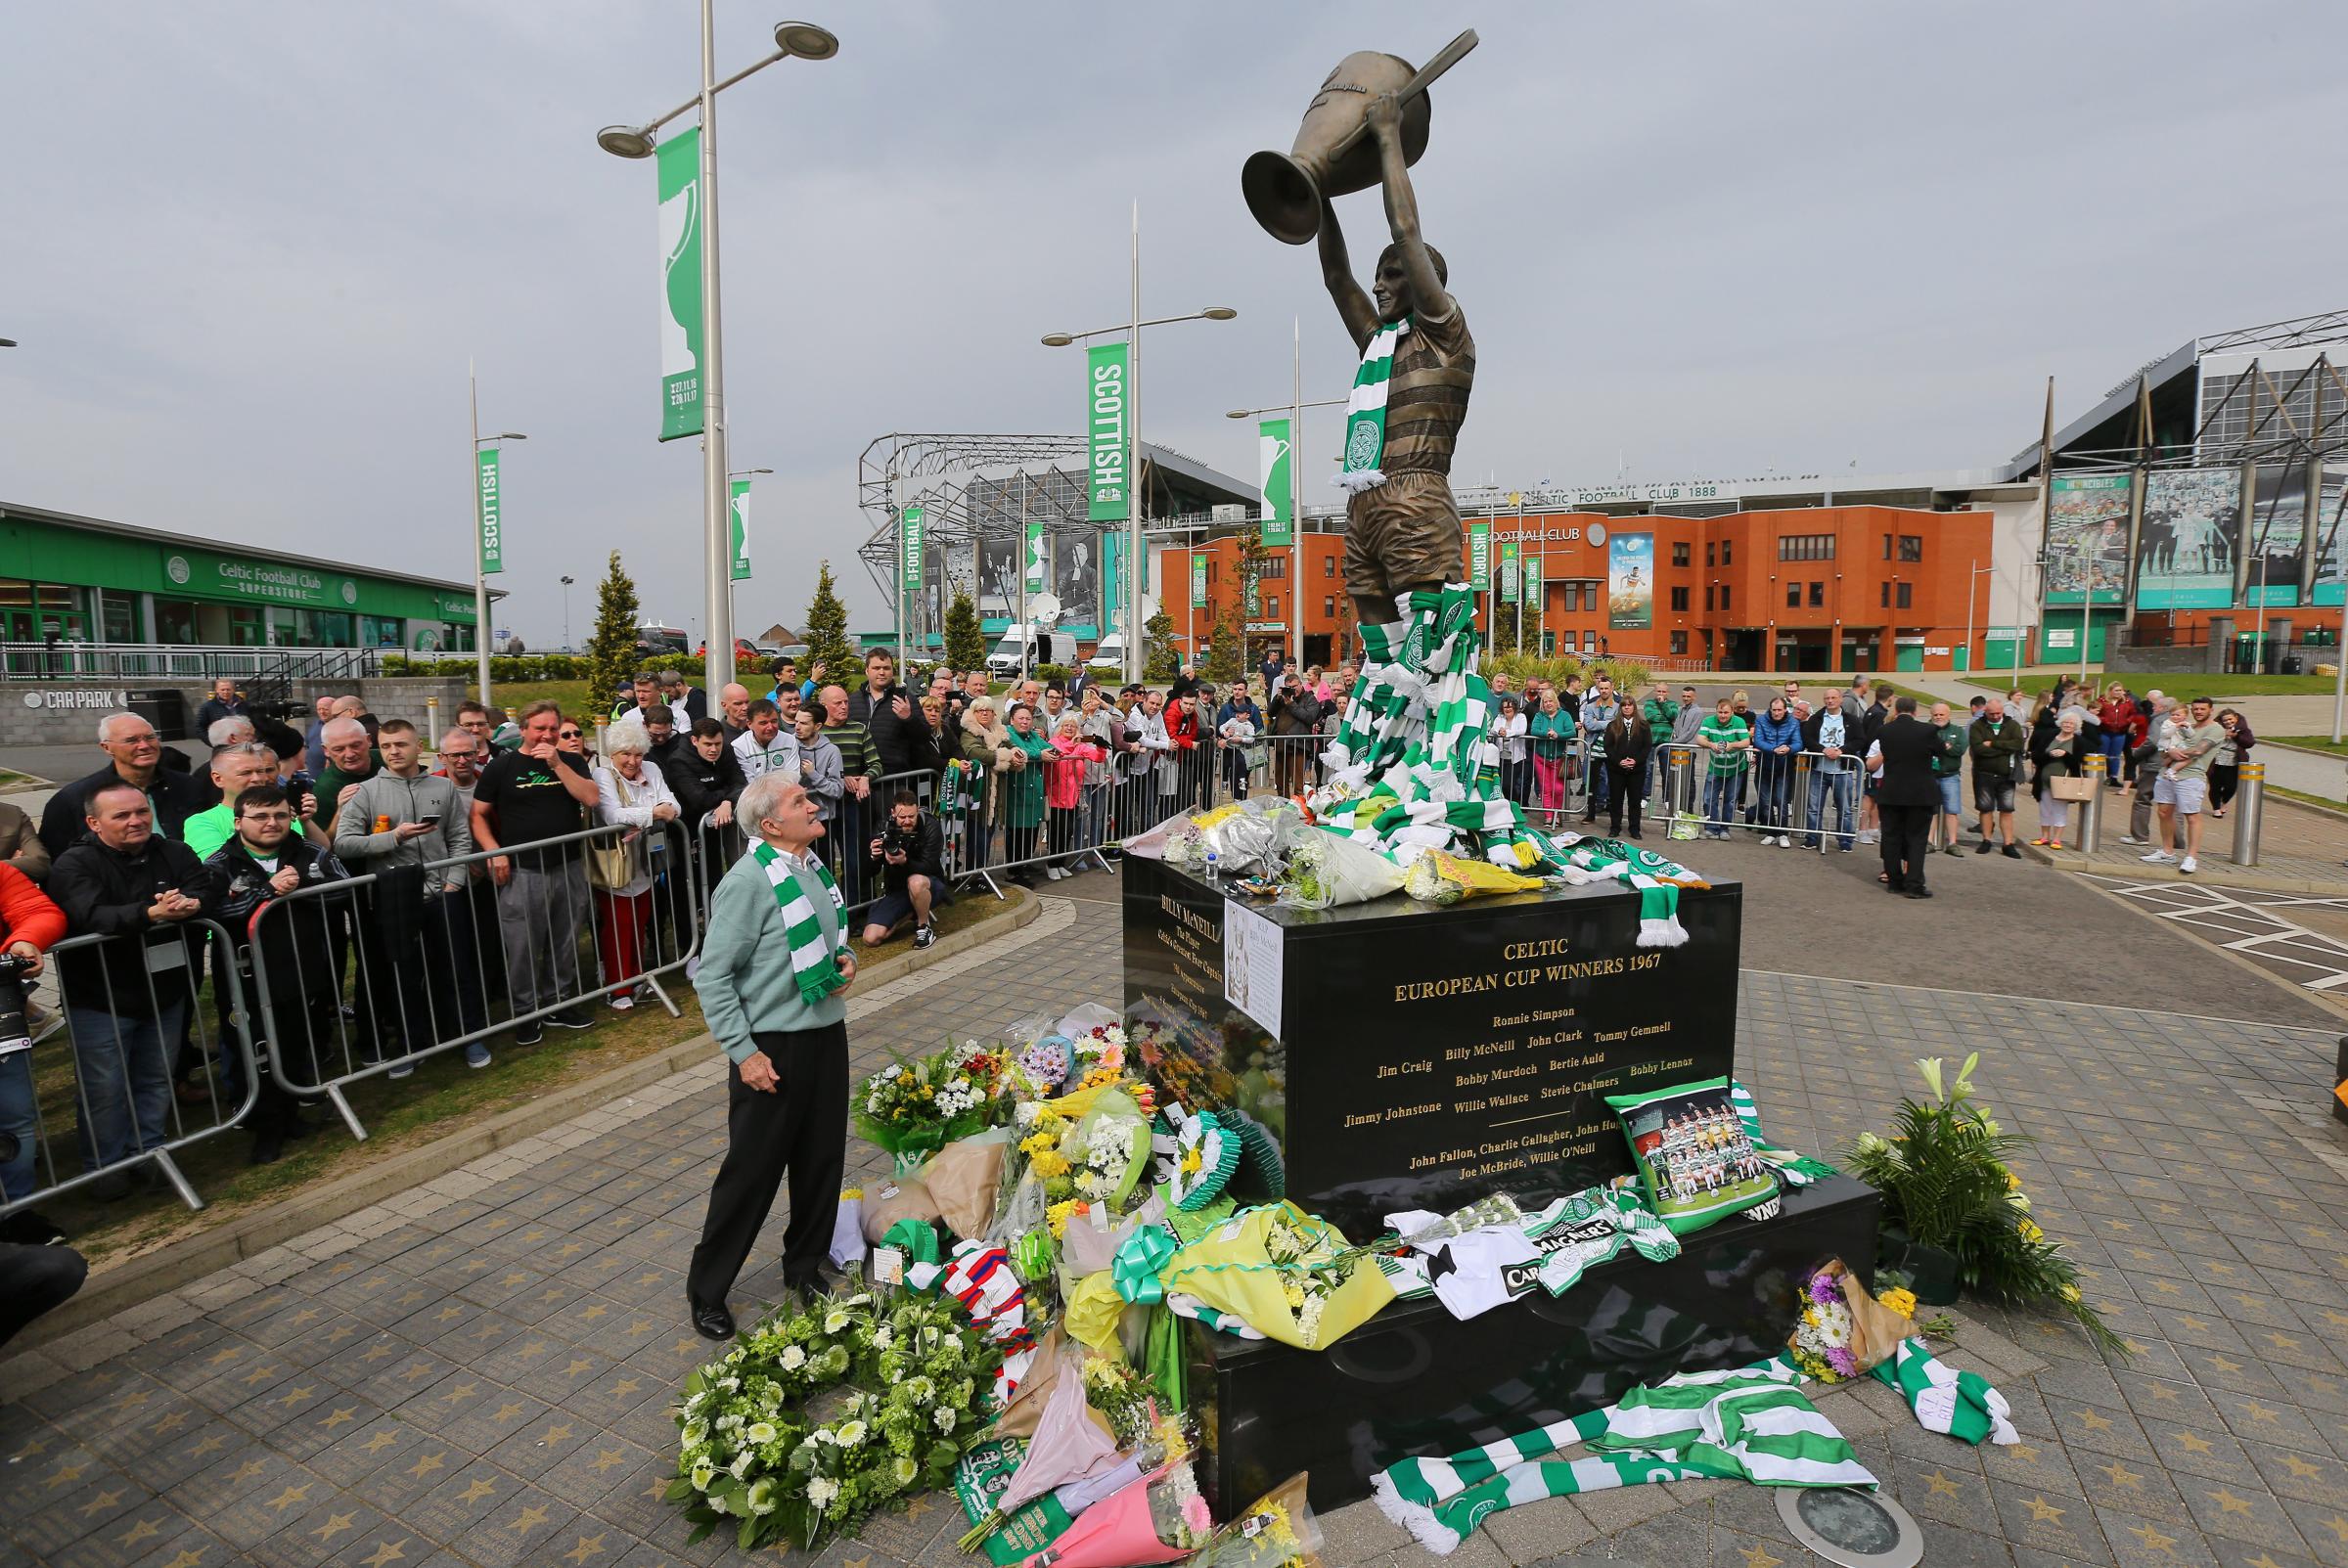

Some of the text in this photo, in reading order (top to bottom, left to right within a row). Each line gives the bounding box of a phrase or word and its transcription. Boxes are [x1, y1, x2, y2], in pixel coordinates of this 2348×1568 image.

[1094, 364, 1122, 485] SCOTTISH
[482, 464, 499, 548] SCOTTISH
[1648, 488, 1680, 500] CLUB
[1689, 486, 1717, 498] 1888
[907, 515, 921, 575] FOOTBALL
[1548, 527, 1581, 541] CLUB
[1472, 533, 1487, 577] HISTORY
[218, 561, 322, 590] Celtic Football Club
[238, 581, 308, 601] SUPERSTORE
[1528, 561, 1538, 600] SINCE 1888
[46, 691, 114, 709] CAR PARK
[946, 782, 955, 811] ELTIC
[1160, 894, 1219, 943] BILLY McNEILL
[1176, 925, 1200, 951] The Player
[1504, 938, 1569, 961] CELTIC
[1192, 952, 1202, 969] Ever
[1202, 961, 1223, 984] Captain
[1394, 952, 1662, 1003] EUROPEAN CUP WINNERS 1967
[1493, 1007, 1575, 1028] Ronnie Simpson
[1445, 1020, 1671, 1061] Billy McNeill John Clark Tommy Gemmell
[1377, 1059, 1433, 1079] Jim Craig
[1455, 1052, 1604, 1088] Bobby Murdoch Bertie Auld
[1344, 1057, 1693, 1129] Jimmy Johnstone Willie Wallace Stevie Chalmers Bobby Lennox
[1409, 1154, 1436, 1170] John
[1439, 1147, 1476, 1164] Fallon,
[1479, 1138, 1518, 1156] Charlie
[1520, 1129, 1573, 1148] Gallagher,
[1575, 1122, 1600, 1138] John
[1459, 1142, 1596, 1181] Joe McBride, Willie O'Neill
[1538, 1223, 1613, 1255] MAGNERS
[963, 1492, 978, 1522] CHALMERS
[1031, 1504, 1048, 1528] THE
[1002, 1528, 1021, 1551] 1967
